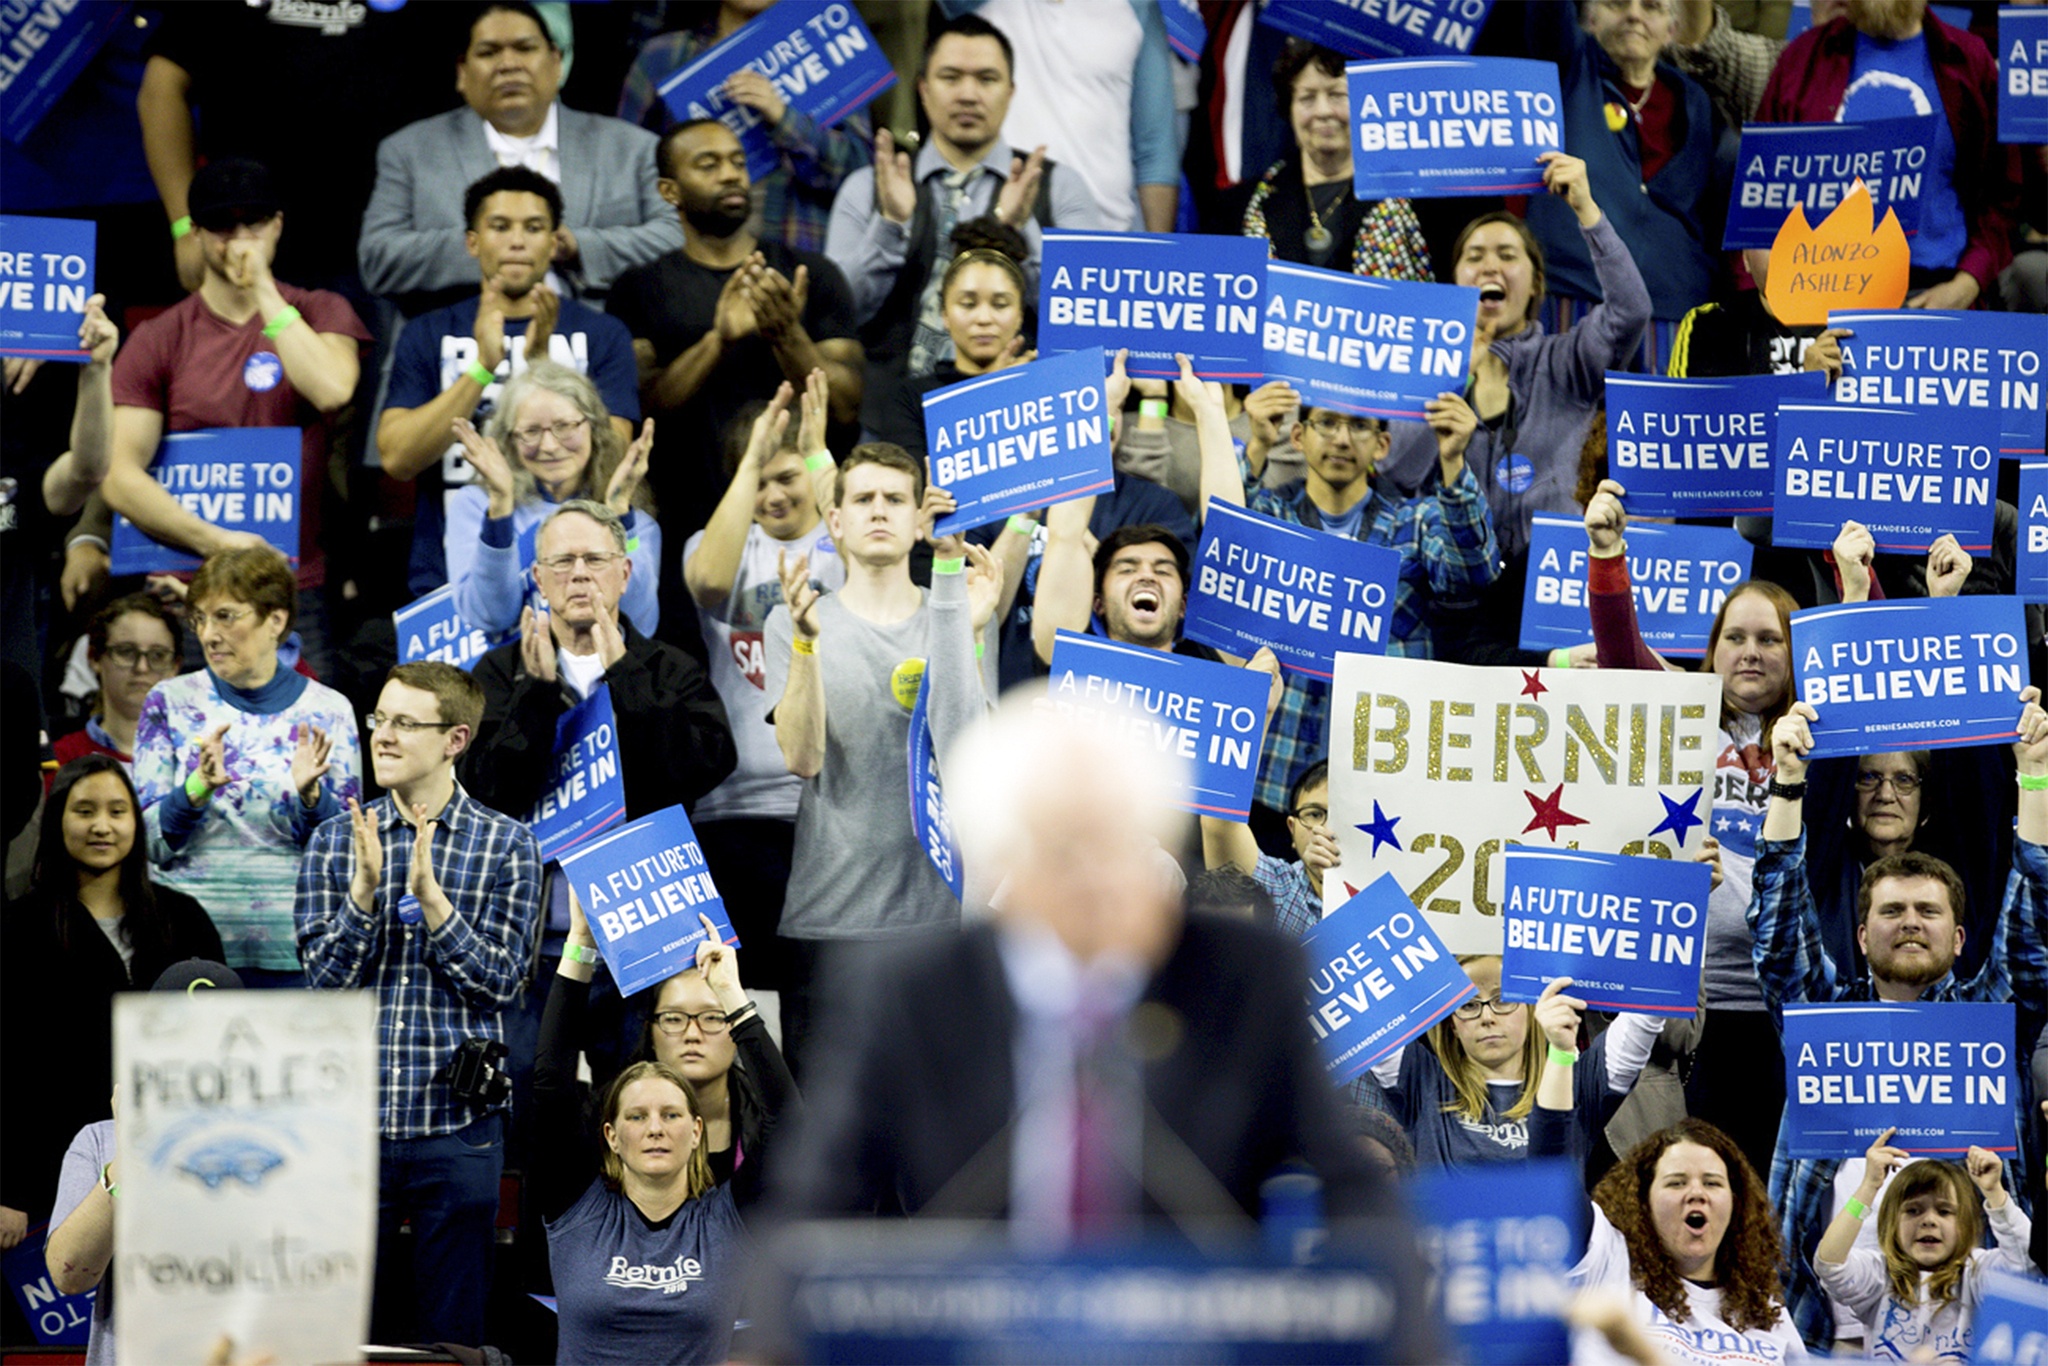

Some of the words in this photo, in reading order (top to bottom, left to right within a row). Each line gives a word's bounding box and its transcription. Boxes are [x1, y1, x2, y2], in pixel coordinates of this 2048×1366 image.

[825, 25, 868, 67] IN
[1432, 16, 1474, 52] IN
[705, 28, 814, 112] FURE
[806, 4, 850, 39] TO
[2009, 39, 2029, 64] A
[1360, 94, 1382, 119] A
[1388, 90, 1510, 118] FUTURE
[1514, 91, 1556, 117] TO
[1360, 118, 1514, 151] BELIEVE
[1522, 118, 1559, 148] IN
[1418, 167, 1507, 177] BERNIESANDERS.COM
[1746, 154, 1766, 177] A
[1774, 151, 1885, 178] FUTURE
[1892, 145, 1927, 171] TO
[1888, 173, 1922, 202] IN
[41, 254, 87, 281] TO
[1793, 242, 1880, 265] ALONZO
[44, 283, 85, 313] IN
[1051, 266, 1073, 290] A
[1081, 267, 1206, 298] FUTURE
[1213, 273, 1259, 300] TO
[1790, 272, 1874, 295] ASHLEY
[1049, 297, 1206, 332] BELIEVE
[1215, 304, 1257, 335] IN
[1266, 294, 1287, 320] A
[1294, 299, 1416, 341] FUTURE
[1423, 318, 1467, 346] TO
[1263, 321, 1414, 374] BELIEVE
[1420, 347, 1463, 378] IN
[1866, 345, 1990, 373] FUTURE
[1998, 350, 2041, 377] TO
[1835, 376, 1990, 407] BELIEVE
[2000, 380, 2040, 411] IN
[936, 427, 953, 453] A
[955, 396, 1055, 446] FUTURE
[1059, 386, 1099, 416] TO
[1616, 410, 1636, 434] A
[1643, 412, 1767, 437] FUTURE
[936, 426, 1060, 487] BELIEVE
[1066, 415, 1103, 451] IN
[1616, 439, 1770, 470] BELIEVE
[1787, 437, 1809, 462] A
[1818, 439, 1944, 468] FUTURE
[1951, 445, 1992, 471] TO
[153, 462, 246, 491] UTURE
[251, 462, 294, 489] TO
[980, 477, 1055, 504] BERNIESANDERS.COM
[1785, 468, 1943, 504] BELIEVE
[1953, 476, 1990, 506] IN
[254, 492, 293, 523] IN
[1672, 490, 1763, 499] BERNIESANDERS.COM
[2029, 494, 2048, 519] A
[1205, 537, 1221, 562] A
[1226, 543, 1336, 598] FUTURE
[1343, 577, 1386, 608] TO
[1539, 547, 1561, 573] A
[1568, 550, 1692, 583] FURE
[1700, 561, 1743, 584] TO
[1198, 565, 1333, 632] BELIEVE
[1340, 608, 1383, 643] IN
[406, 634, 426, 659] A
[1235, 629, 1316, 659] BERNIESANDERS.COM
[1803, 646, 1824, 672] A
[1831, 635, 1963, 668] FUTURE
[1970, 633, 2018, 658] TO
[1059, 669, 1078, 695] A
[1085, 674, 1205, 724] FUTURE
[1212, 702, 1256, 733] TO
[1803, 666, 1967, 706] BELIEVE
[1978, 664, 2022, 693] IN
[584, 723, 612, 758] TO
[1352, 690, 1706, 787] BERNIE
[1864, 718, 1961, 733] BERNIESANDERS.COM
[1208, 734, 1252, 770] IN
[590, 750, 617, 790] IN
[589, 882, 610, 910] A
[606, 845, 690, 899] FUTURE
[682, 841, 703, 867] TO
[598, 873, 706, 943] BELIEVE
[698, 870, 719, 901] IN
[1509, 885, 1523, 911] A
[1527, 886, 1642, 923] FUTURE
[1651, 900, 1698, 928] TO
[1308, 942, 1373, 996] URE
[1367, 912, 1415, 951] TO
[1507, 918, 1640, 960] BELIEVE
[1650, 933, 1694, 966] IN
[1308, 967, 1396, 1041] IEVE
[1390, 935, 1440, 981] IN
[1797, 1042, 1818, 1068] A
[1825, 1041, 1952, 1068] FUTURE
[1959, 1042, 2006, 1069] TO
[1797, 1074, 1953, 1105] BELIEVE
[1965, 1075, 2006, 1105] IN
[606, 1253, 702, 1282] Bernie
[40, 1303, 88, 1336] TO
[1879, 1298, 1975, 1351] Bernie
